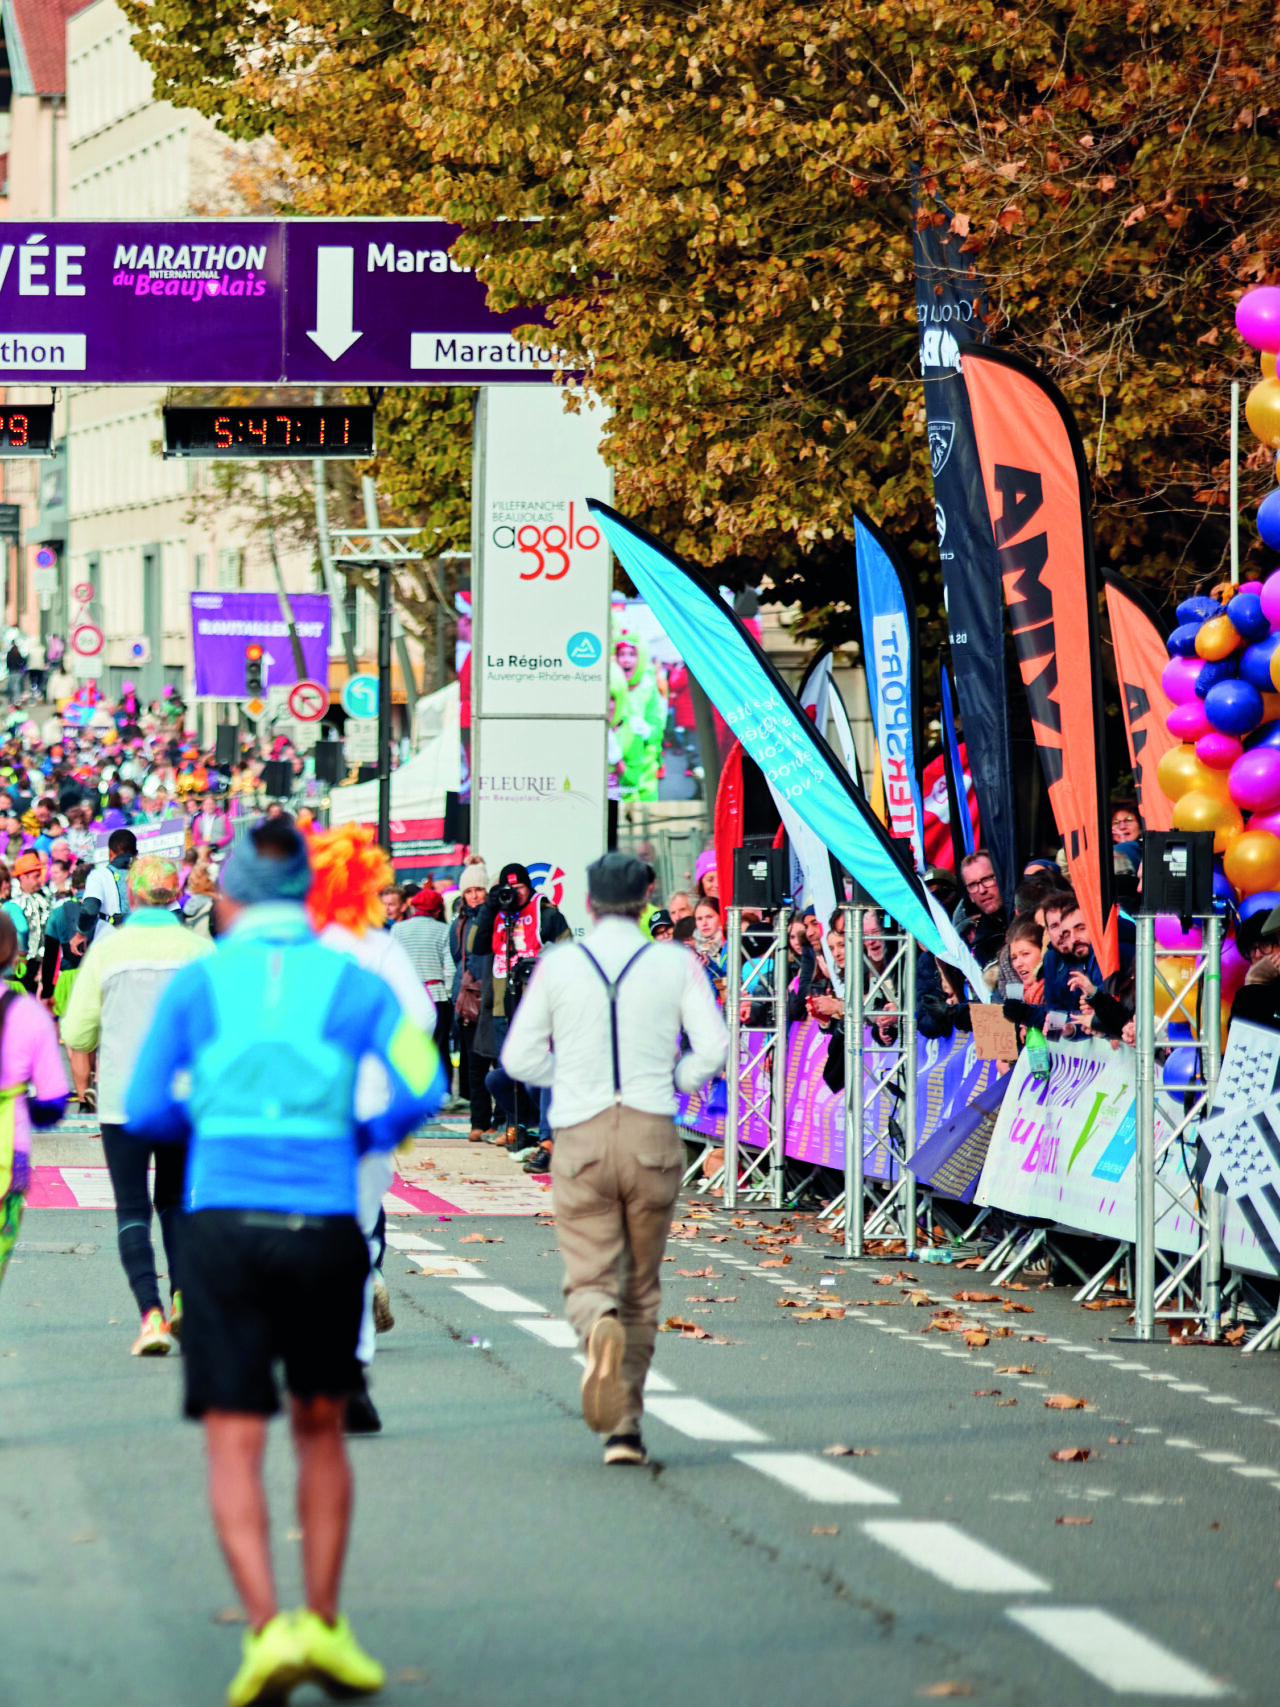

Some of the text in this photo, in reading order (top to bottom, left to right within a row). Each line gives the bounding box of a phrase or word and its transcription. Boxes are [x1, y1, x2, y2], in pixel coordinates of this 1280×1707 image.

[113, 244, 267, 270] MARATHON
[149, 269, 220, 280] INTERNATIONAL
[112, 270, 267, 302] du Beaujolais
[435, 338, 563, 363] Maratho
[215, 414, 350, 449] 5:47:11
[492, 501, 565, 511] VILLEFRANCHE
[492, 512, 554, 522] BEAUJOLAIS
[492, 501, 601, 581] agglo
[487, 655, 563, 670] La Région
[487, 671, 602, 683] Auvergne-Rhône-Alpes
[479, 776, 557, 795] FLEURIE
